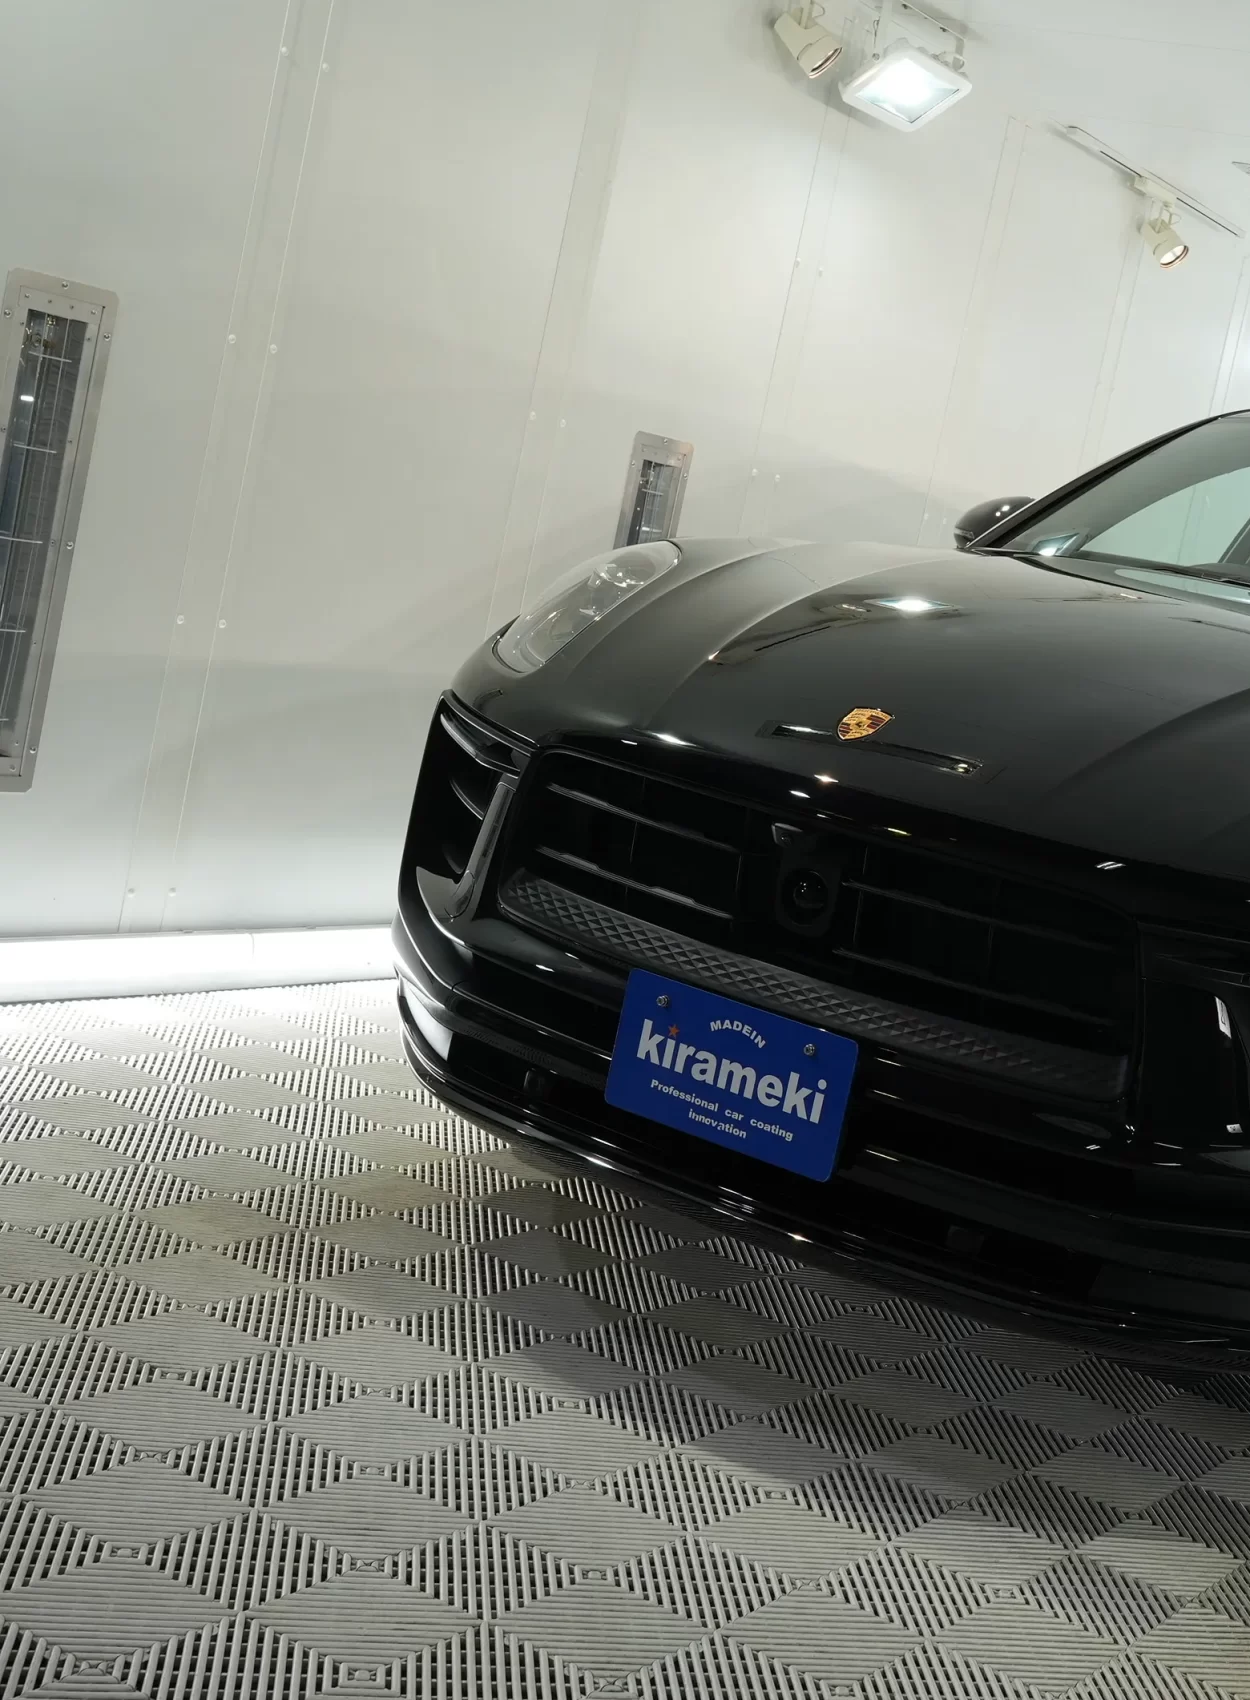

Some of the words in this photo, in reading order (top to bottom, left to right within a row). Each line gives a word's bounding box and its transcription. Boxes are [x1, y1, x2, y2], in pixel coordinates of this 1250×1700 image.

[637, 1018, 827, 1124] kirameki
[650, 1079, 719, 1112] Professional
[724, 1108, 744, 1121] car
[749, 1118, 794, 1142] coating
[688, 1108, 747, 1139] innovation
